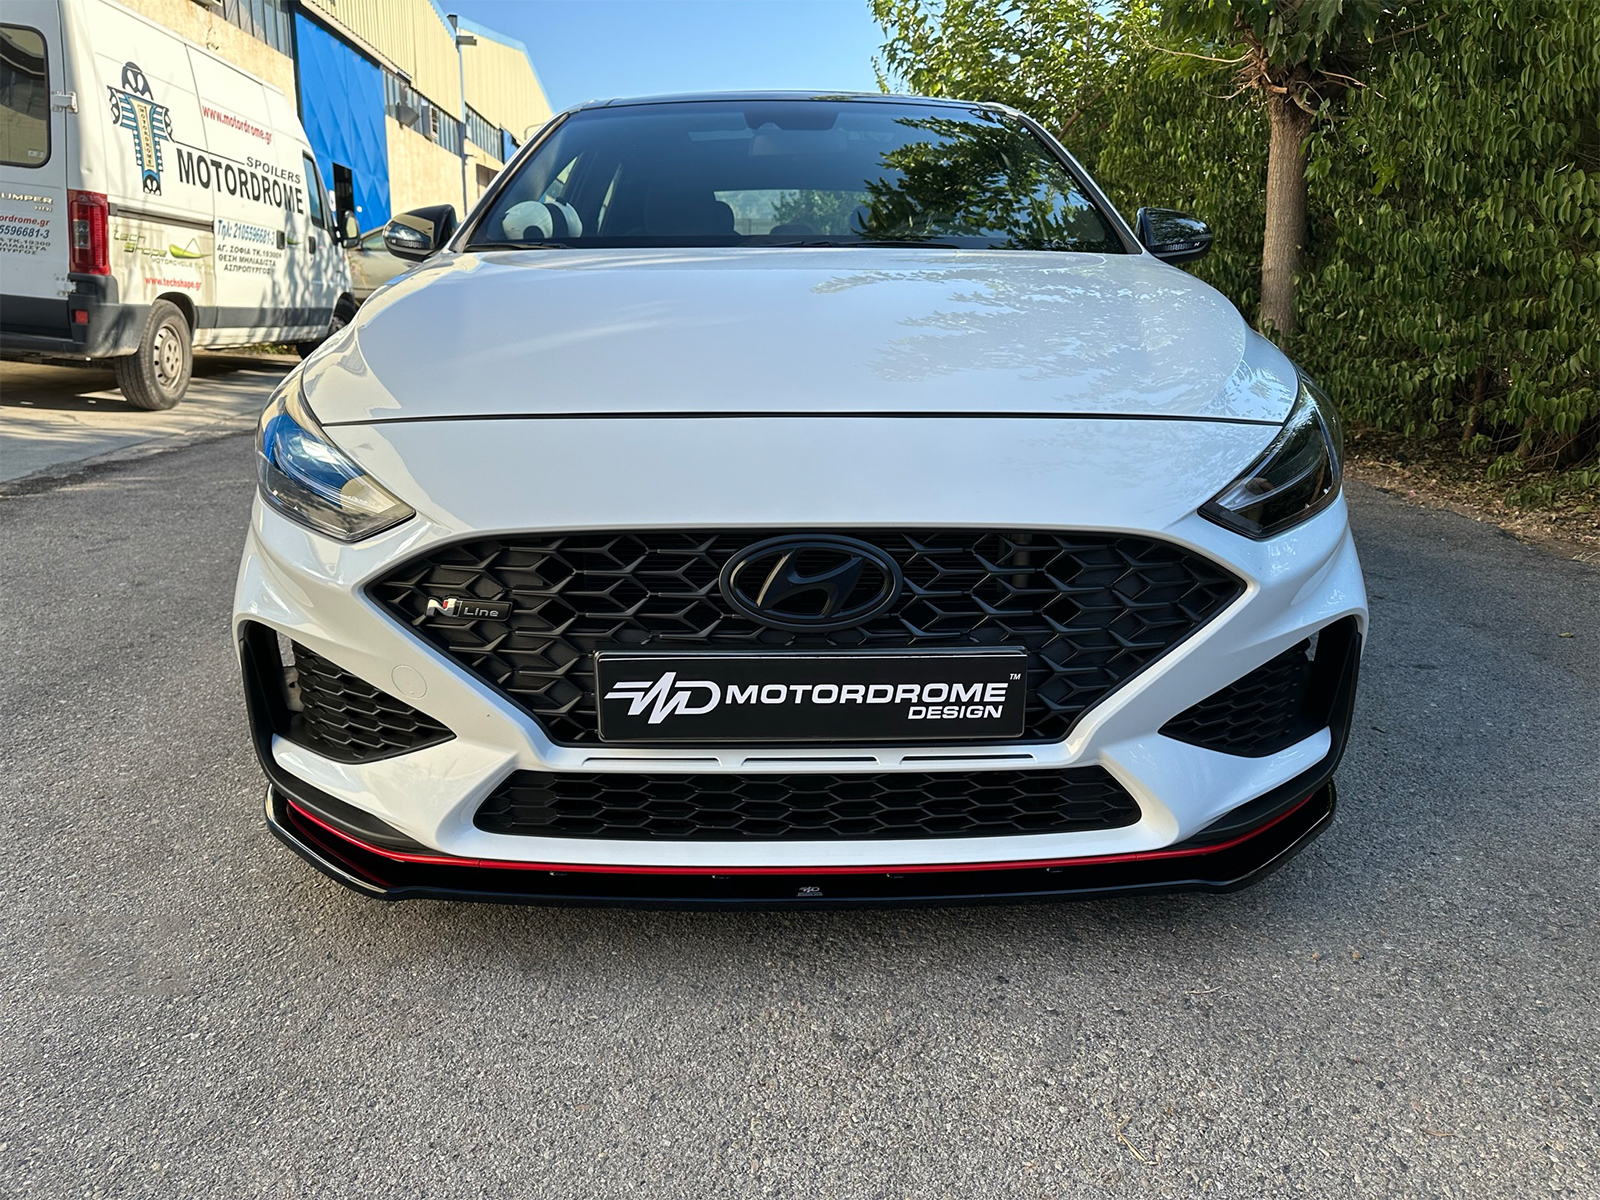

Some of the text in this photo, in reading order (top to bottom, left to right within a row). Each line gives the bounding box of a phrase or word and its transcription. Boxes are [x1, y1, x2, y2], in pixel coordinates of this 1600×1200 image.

[202, 105, 272, 145] www.motordrome.gr
[176, 147, 304, 215] MOTORDROME
[246, 156, 301, 184] SPOILERS
[144, 276, 202, 291] www.techshape.gr
[463, 606, 499, 617] Line
[725, 683, 1009, 705] MOTORDROME
[907, 705, 1003, 720] DESIGN
